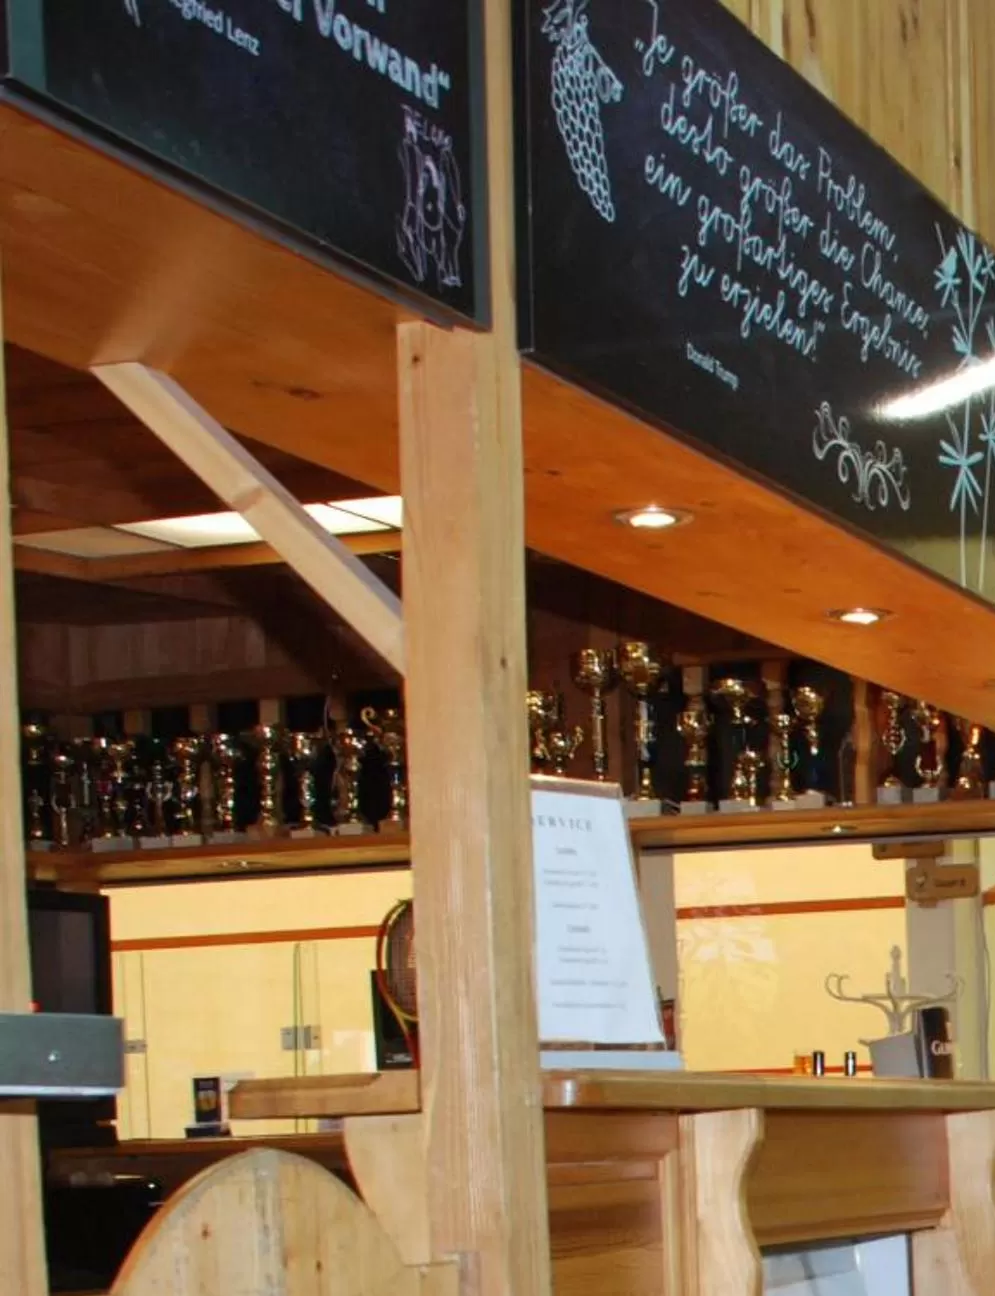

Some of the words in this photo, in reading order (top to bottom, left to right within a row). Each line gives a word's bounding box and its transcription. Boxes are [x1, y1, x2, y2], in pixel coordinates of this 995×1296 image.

[226, 15, 260, 56] Lenz
[682, 55, 763, 138] größer
[769, 112, 811, 180] das
[645, 153, 692, 207] ein
[661, 82, 733, 176] desto
[739, 165, 814, 243] größer
[820, 211, 855, 272] die
[677, 245, 715, 297] zu
[532, 814, 593, 833] ERVICE
